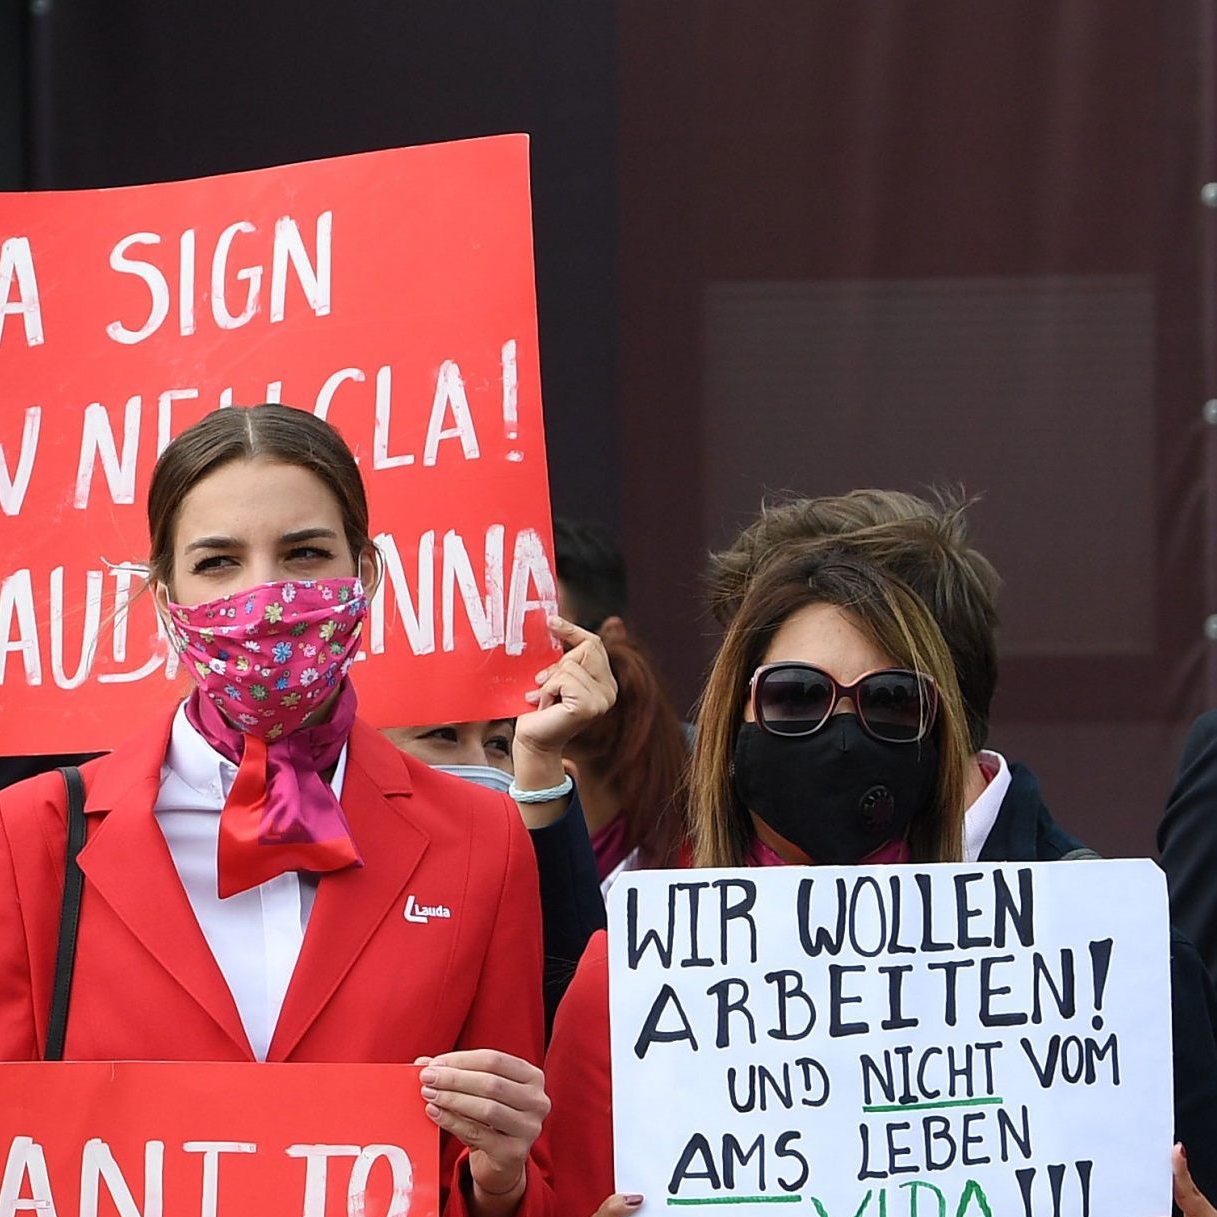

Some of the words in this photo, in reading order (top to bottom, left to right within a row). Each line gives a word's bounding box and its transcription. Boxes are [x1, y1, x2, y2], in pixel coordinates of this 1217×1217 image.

[106, 211, 332, 345] SIGN
[627, 879, 757, 970] WIR
[797, 868, 1035, 957] WOLLEN
[634, 938, 1114, 1060] ARBEITEN!
[728, 1058, 830, 1113] UND
[861, 1041, 1002, 1105] NICHT
[1021, 1032, 1120, 1088] VOM
[667, 1131, 809, 1195] AMS
[857, 1105, 1032, 1181] LEBEN
